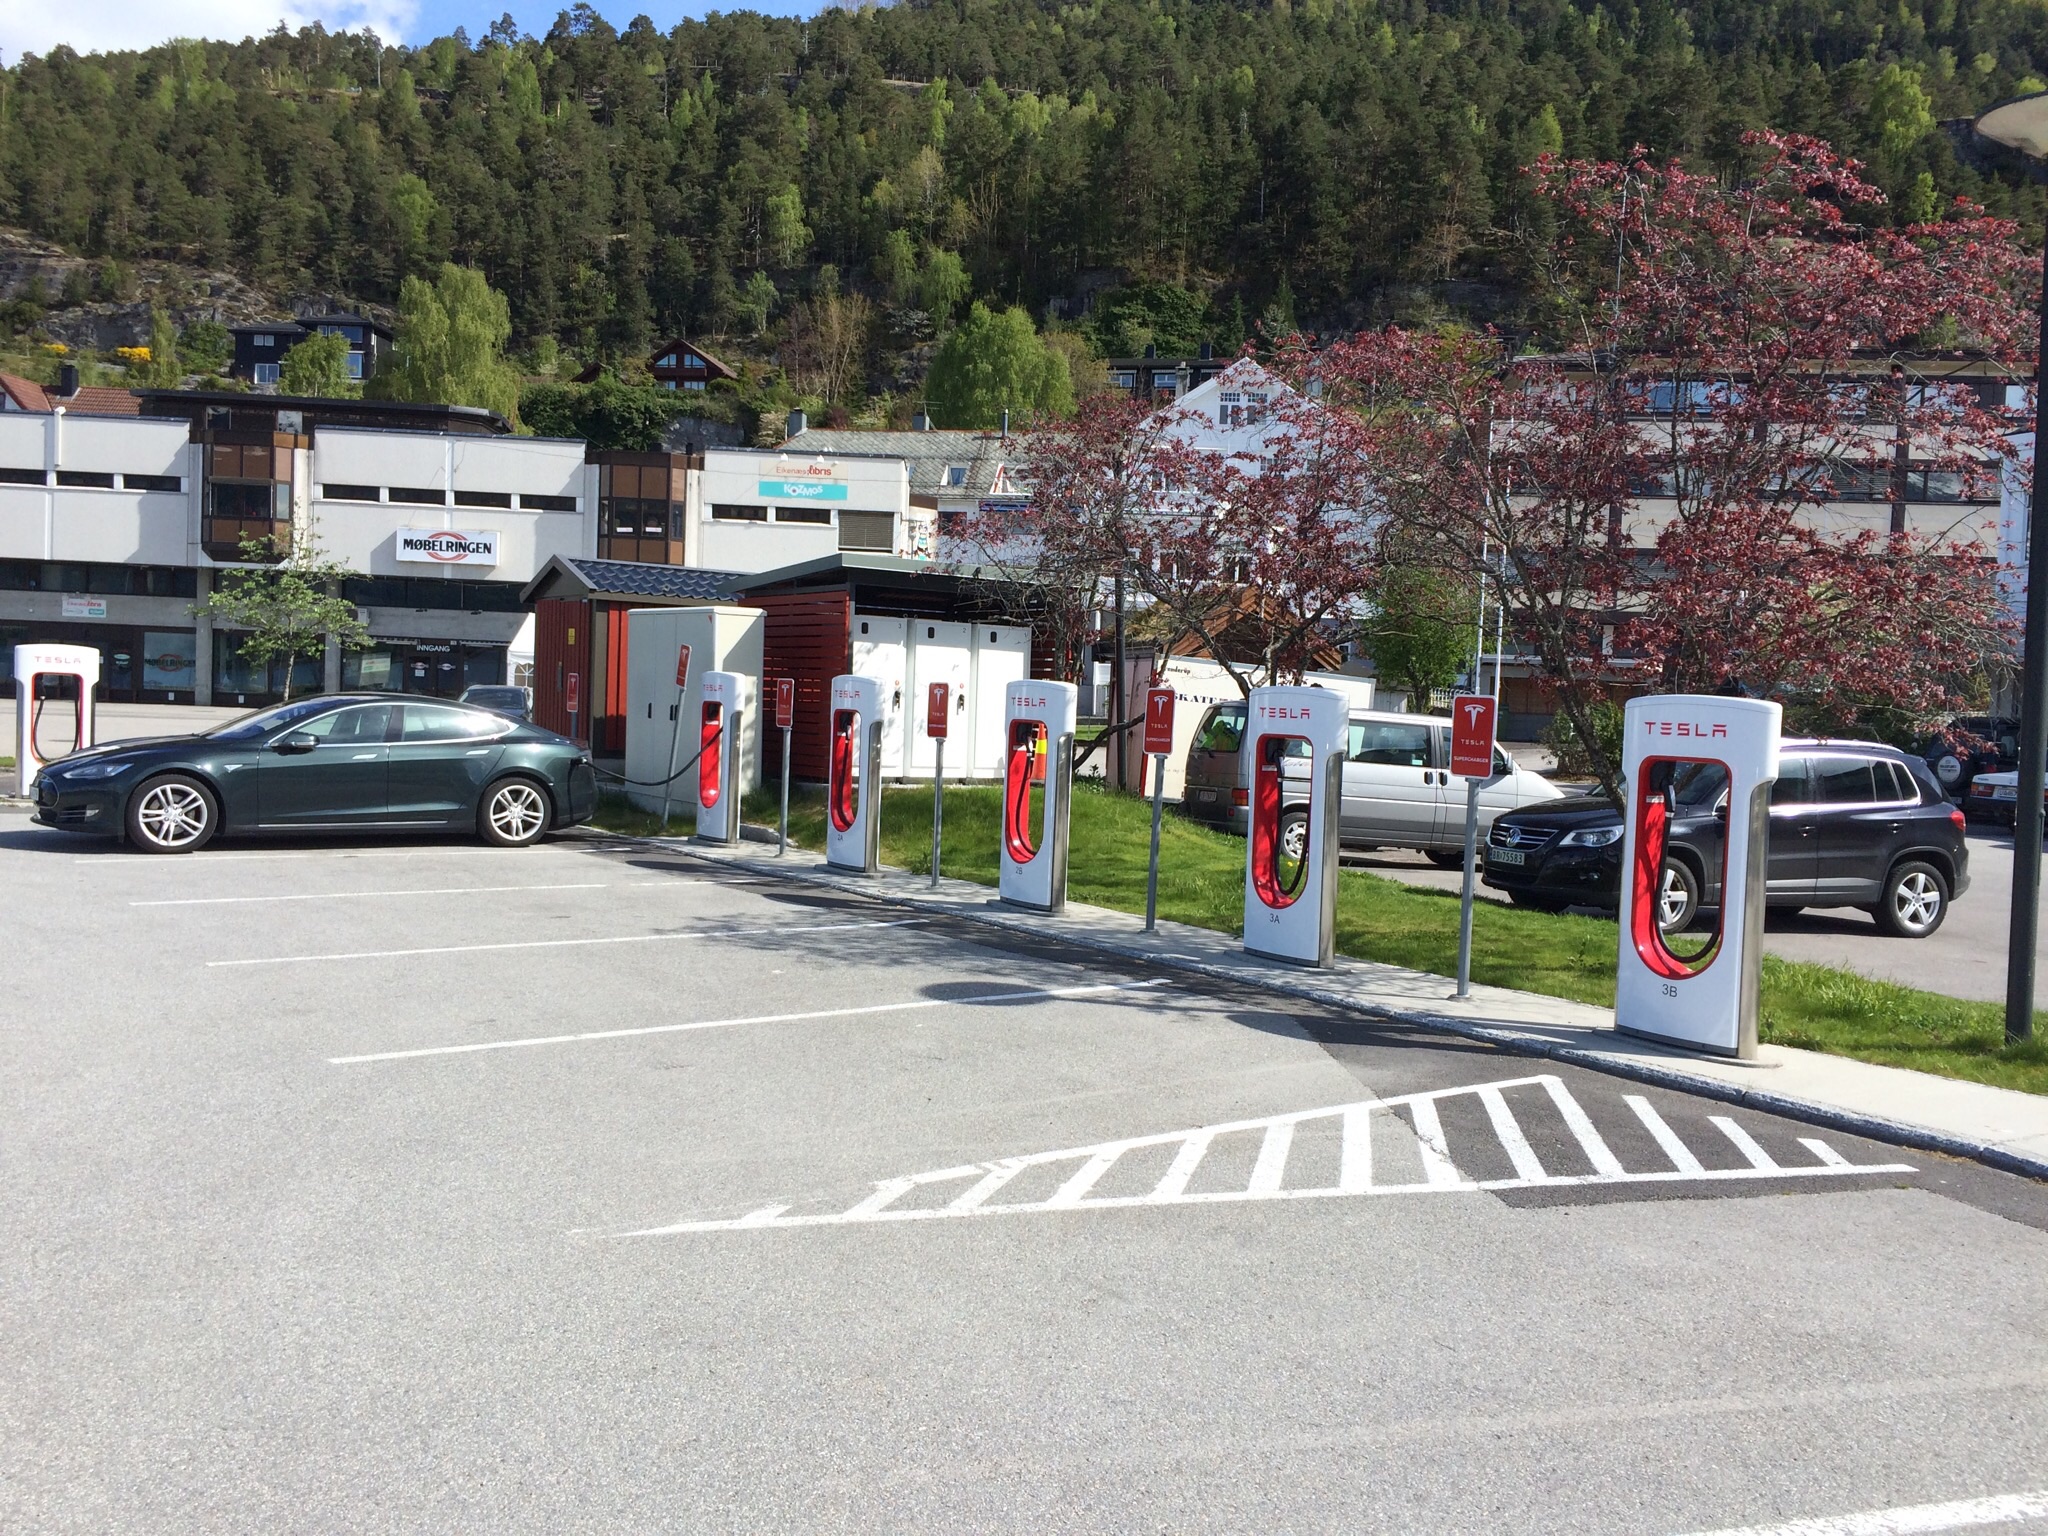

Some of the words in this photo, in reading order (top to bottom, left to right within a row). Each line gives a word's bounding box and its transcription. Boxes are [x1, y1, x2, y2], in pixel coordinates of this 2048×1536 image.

[403, 538, 492, 555] MØBELRINGEN
[416, 645, 450, 653] INNGANG
[34, 656, 81, 664] TESLA
[703, 684, 723, 692] TESLA
[835, 689, 860, 699] TESLA
[1011, 697, 1046, 707] TESLA
[1259, 707, 1311, 719] TESLA
[1644, 721, 1727, 738] TESLA
[1453, 755, 1489, 763] SUPERCHARGER
[1502, 851, 1523, 864] 75583
[1269, 912, 1281, 924] 3A
[1661, 983, 1678, 998] 3B
